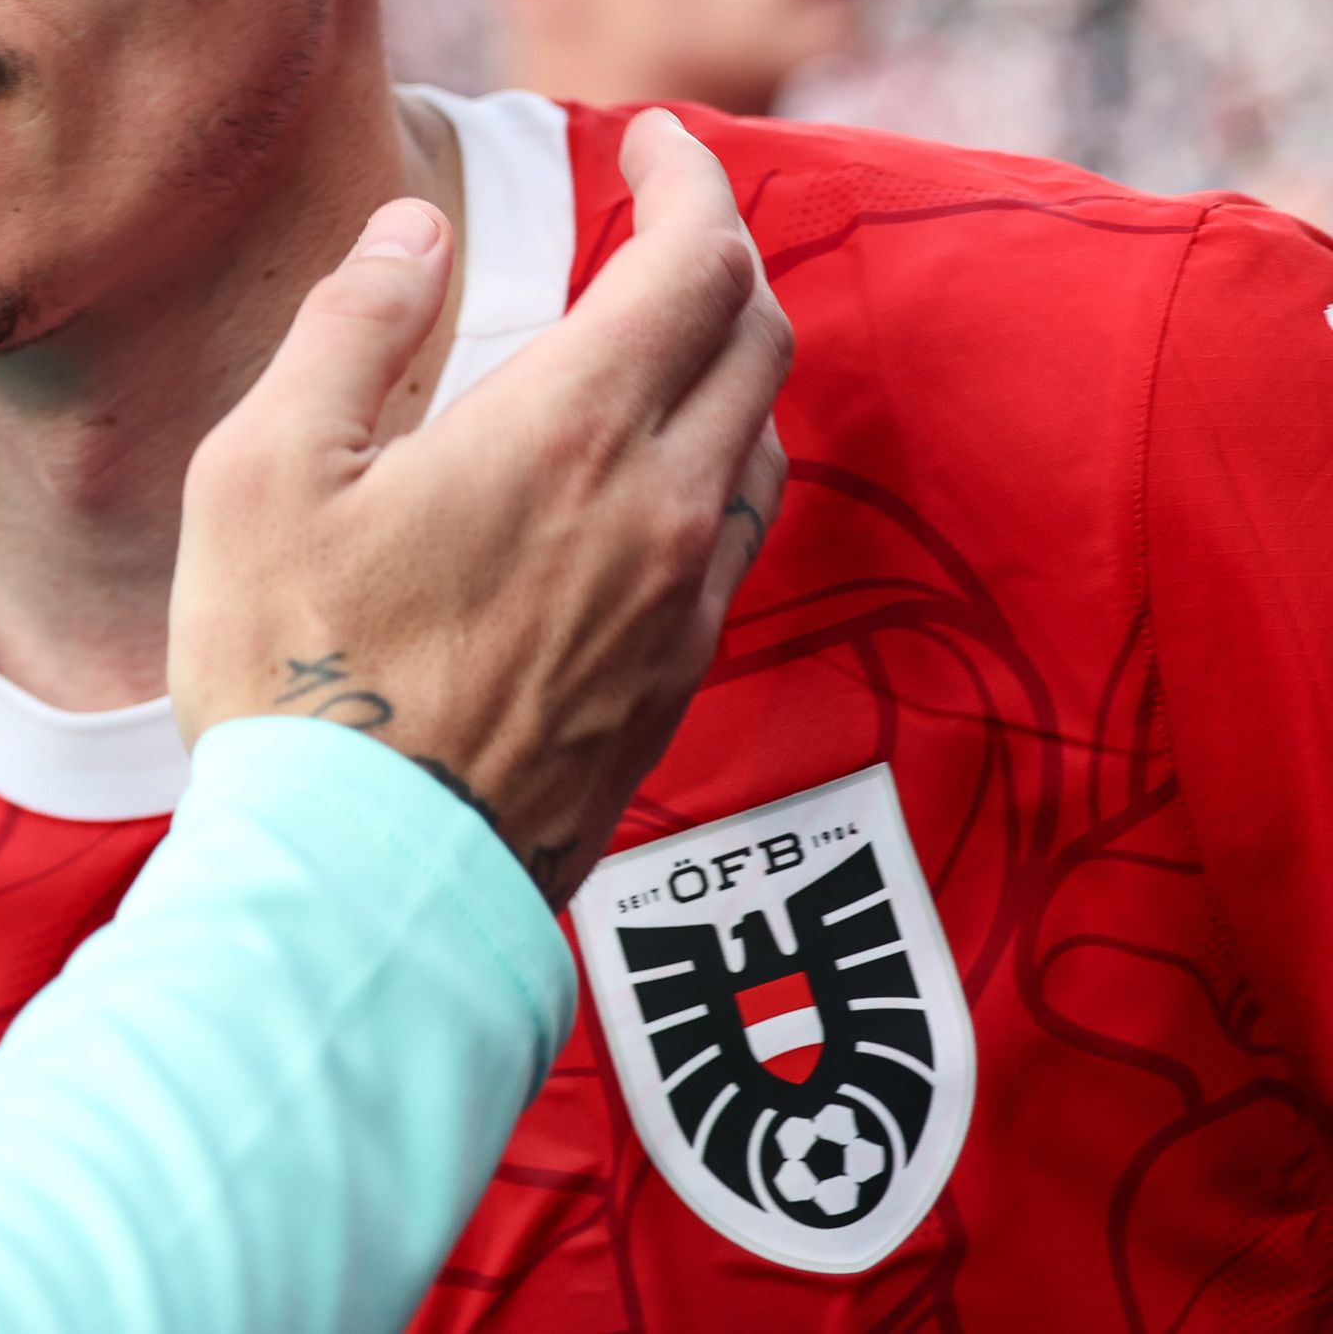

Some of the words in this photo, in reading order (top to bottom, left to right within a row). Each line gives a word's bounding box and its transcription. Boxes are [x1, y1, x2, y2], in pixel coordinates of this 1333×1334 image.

[616, 887, 661, 914] SEIT
[668, 831, 805, 904] ÖFB
[810, 822, 860, 848] 1904
